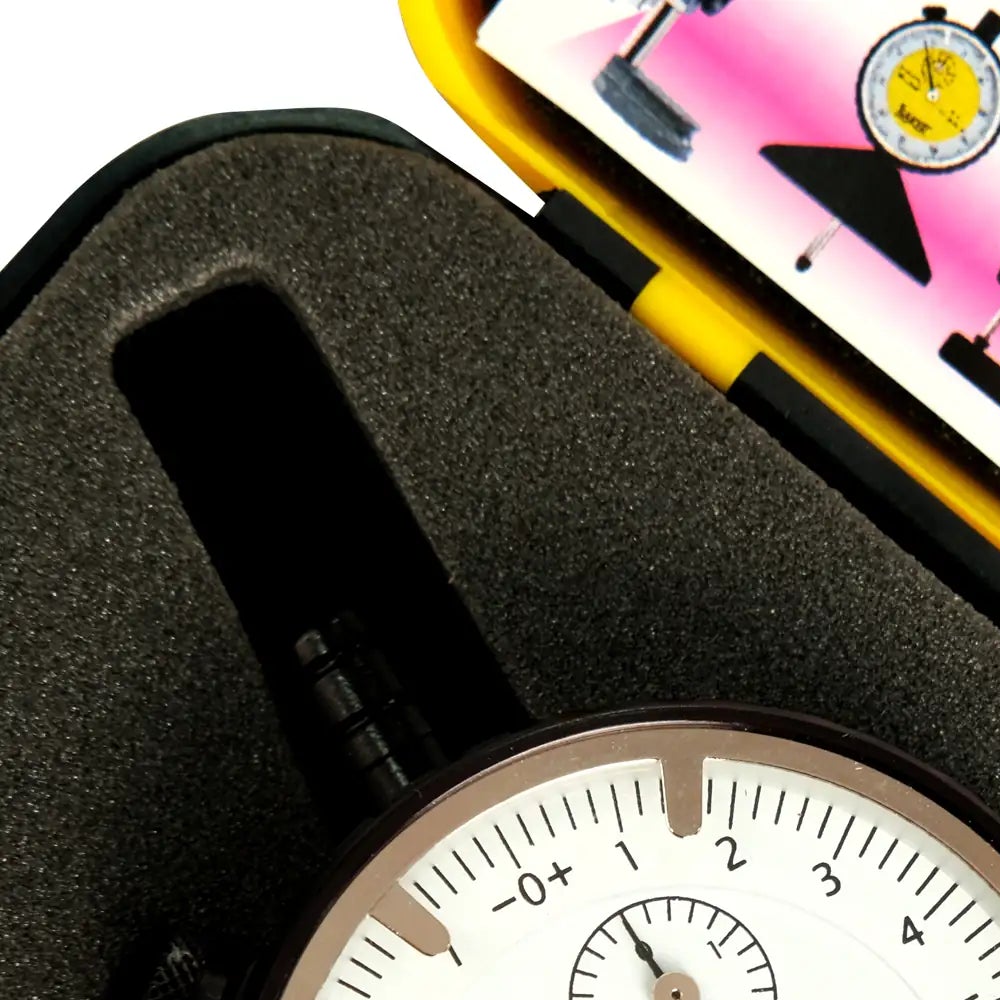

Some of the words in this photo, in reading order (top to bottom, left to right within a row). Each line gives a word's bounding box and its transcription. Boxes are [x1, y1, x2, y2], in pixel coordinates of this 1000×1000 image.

[614, 840, 639, 871] 1
[714, 835, 747, 872] 2
[811, 861, 841, 897] 3
[902, 915, 925, 946] 4
[706, 940, 722, 959] 1
